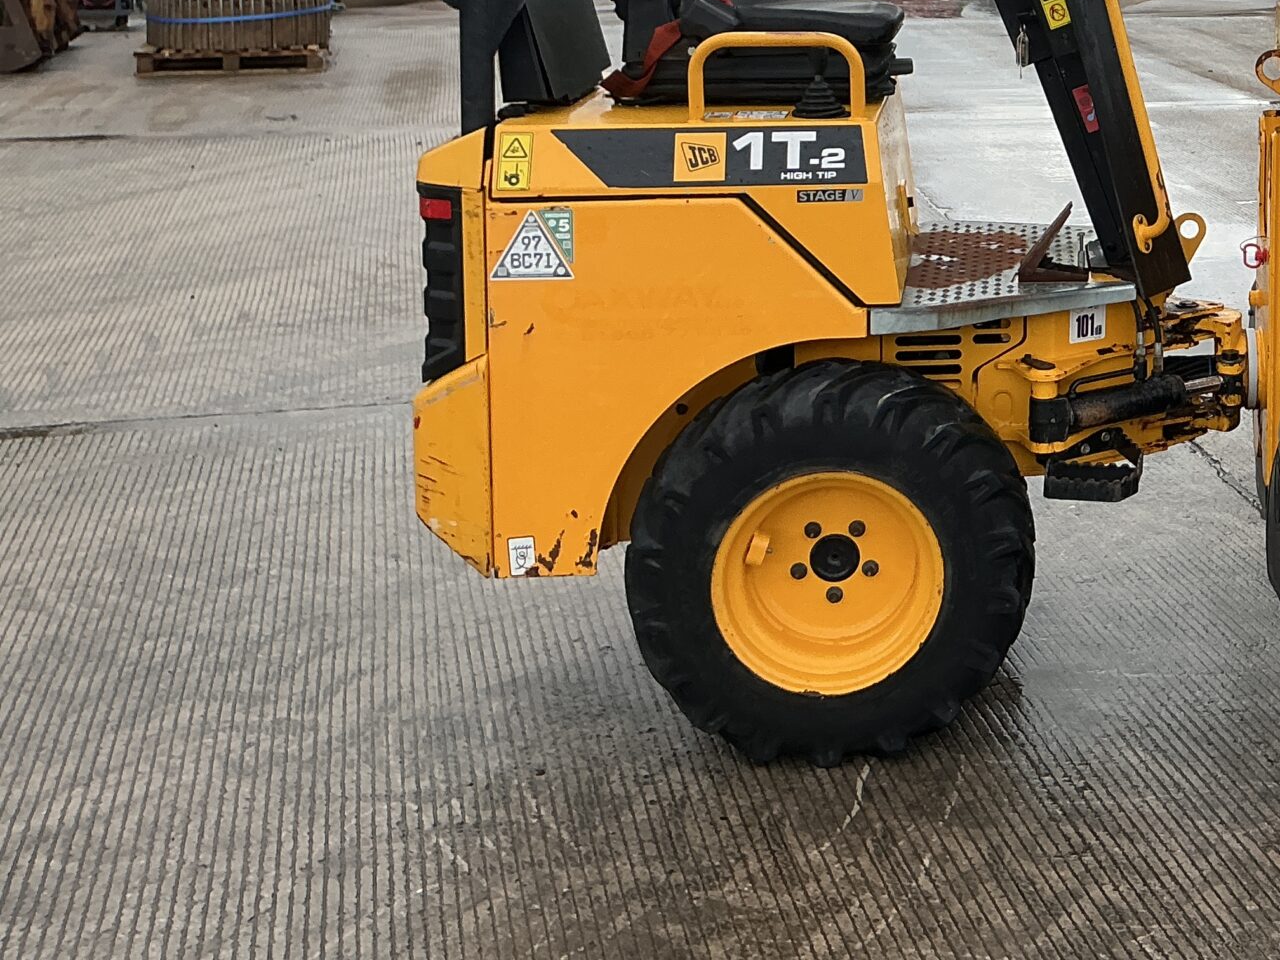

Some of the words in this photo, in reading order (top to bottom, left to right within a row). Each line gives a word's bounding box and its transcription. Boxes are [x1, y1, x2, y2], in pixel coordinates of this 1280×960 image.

[687, 145, 718, 169] JCB
[780, 171, 813, 180] HIGH
[815, 171, 837, 180] TIP
[798, 190, 843, 202] STAGE
[558, 218, 570, 232] 5
[521, 235, 542, 252] 97
[1076, 313, 1095, 338] 101
